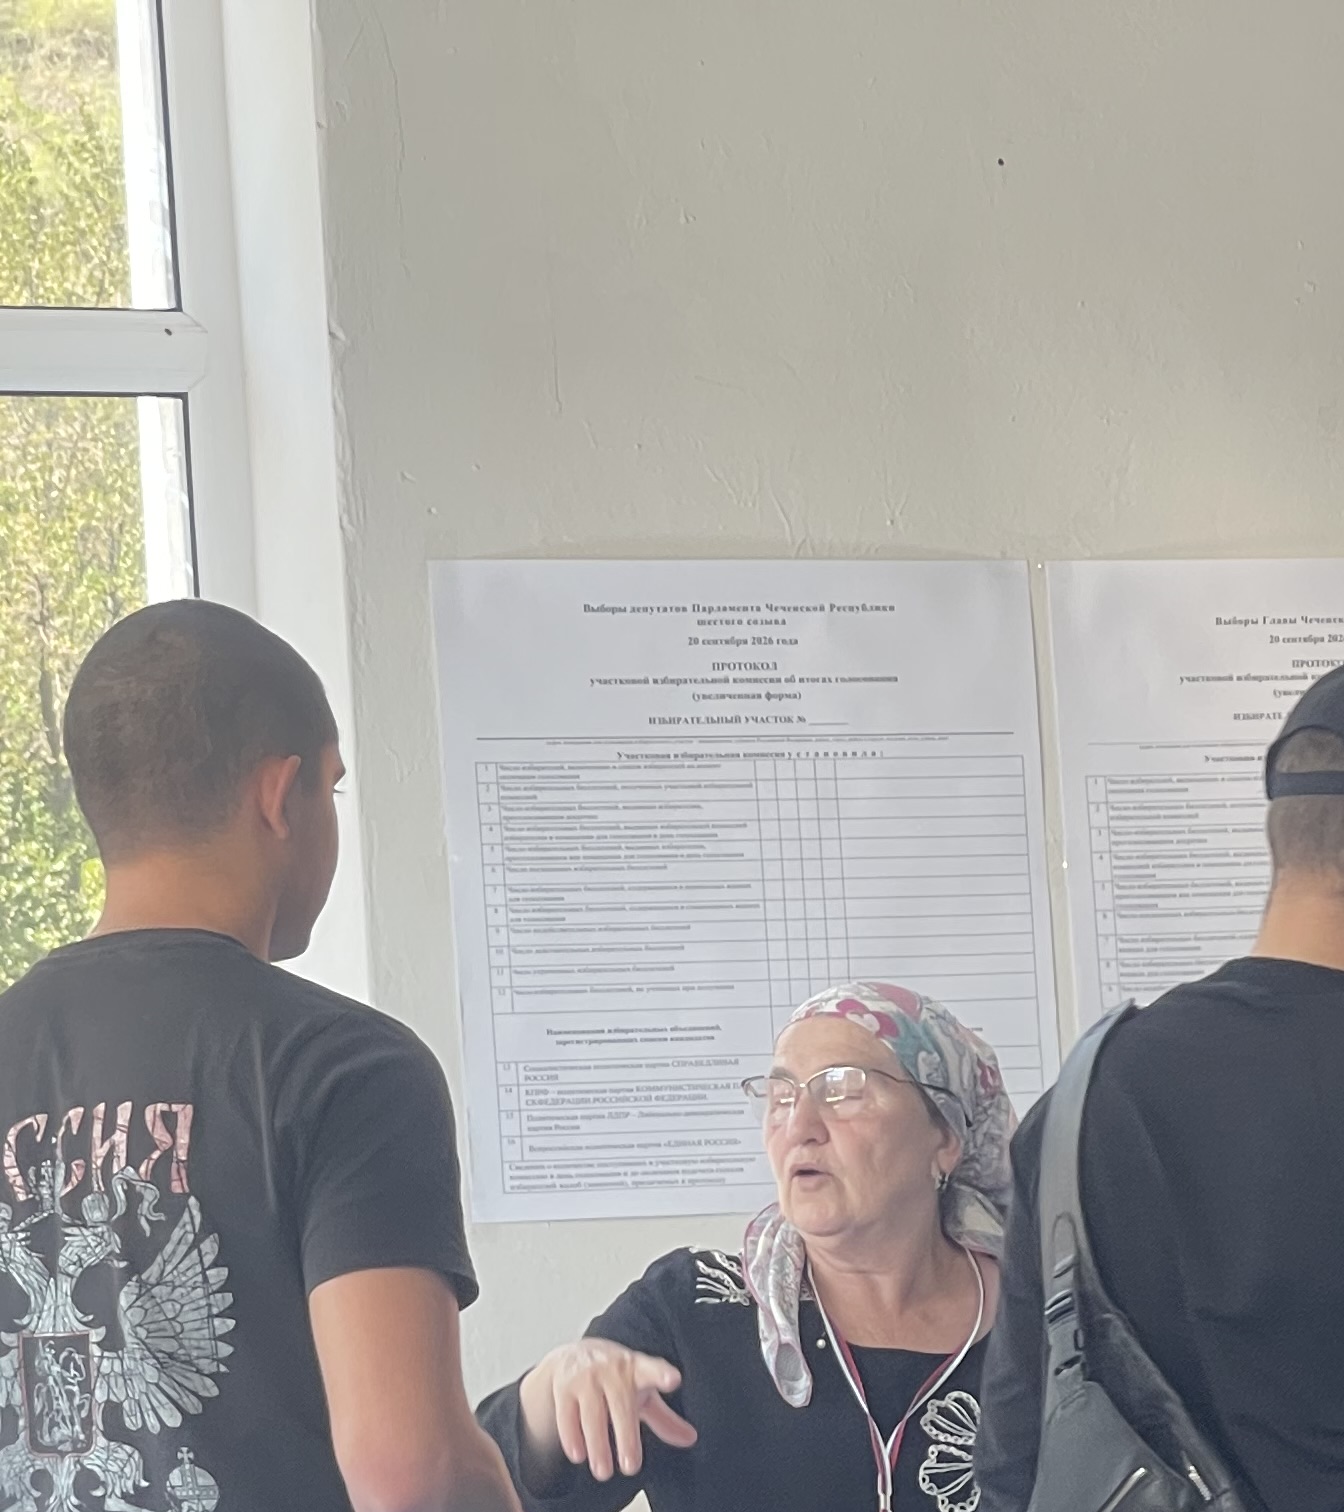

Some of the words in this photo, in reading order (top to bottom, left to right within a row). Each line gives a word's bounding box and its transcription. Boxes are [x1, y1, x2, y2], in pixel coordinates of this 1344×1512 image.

[583, 603, 627, 615] Выборы
[765, 602, 825, 613] Чеченской
[688, 636, 700, 646] 20
[751, 635, 774, 646] 2026
[712, 660, 778, 672] ПРОТОКОЛ
